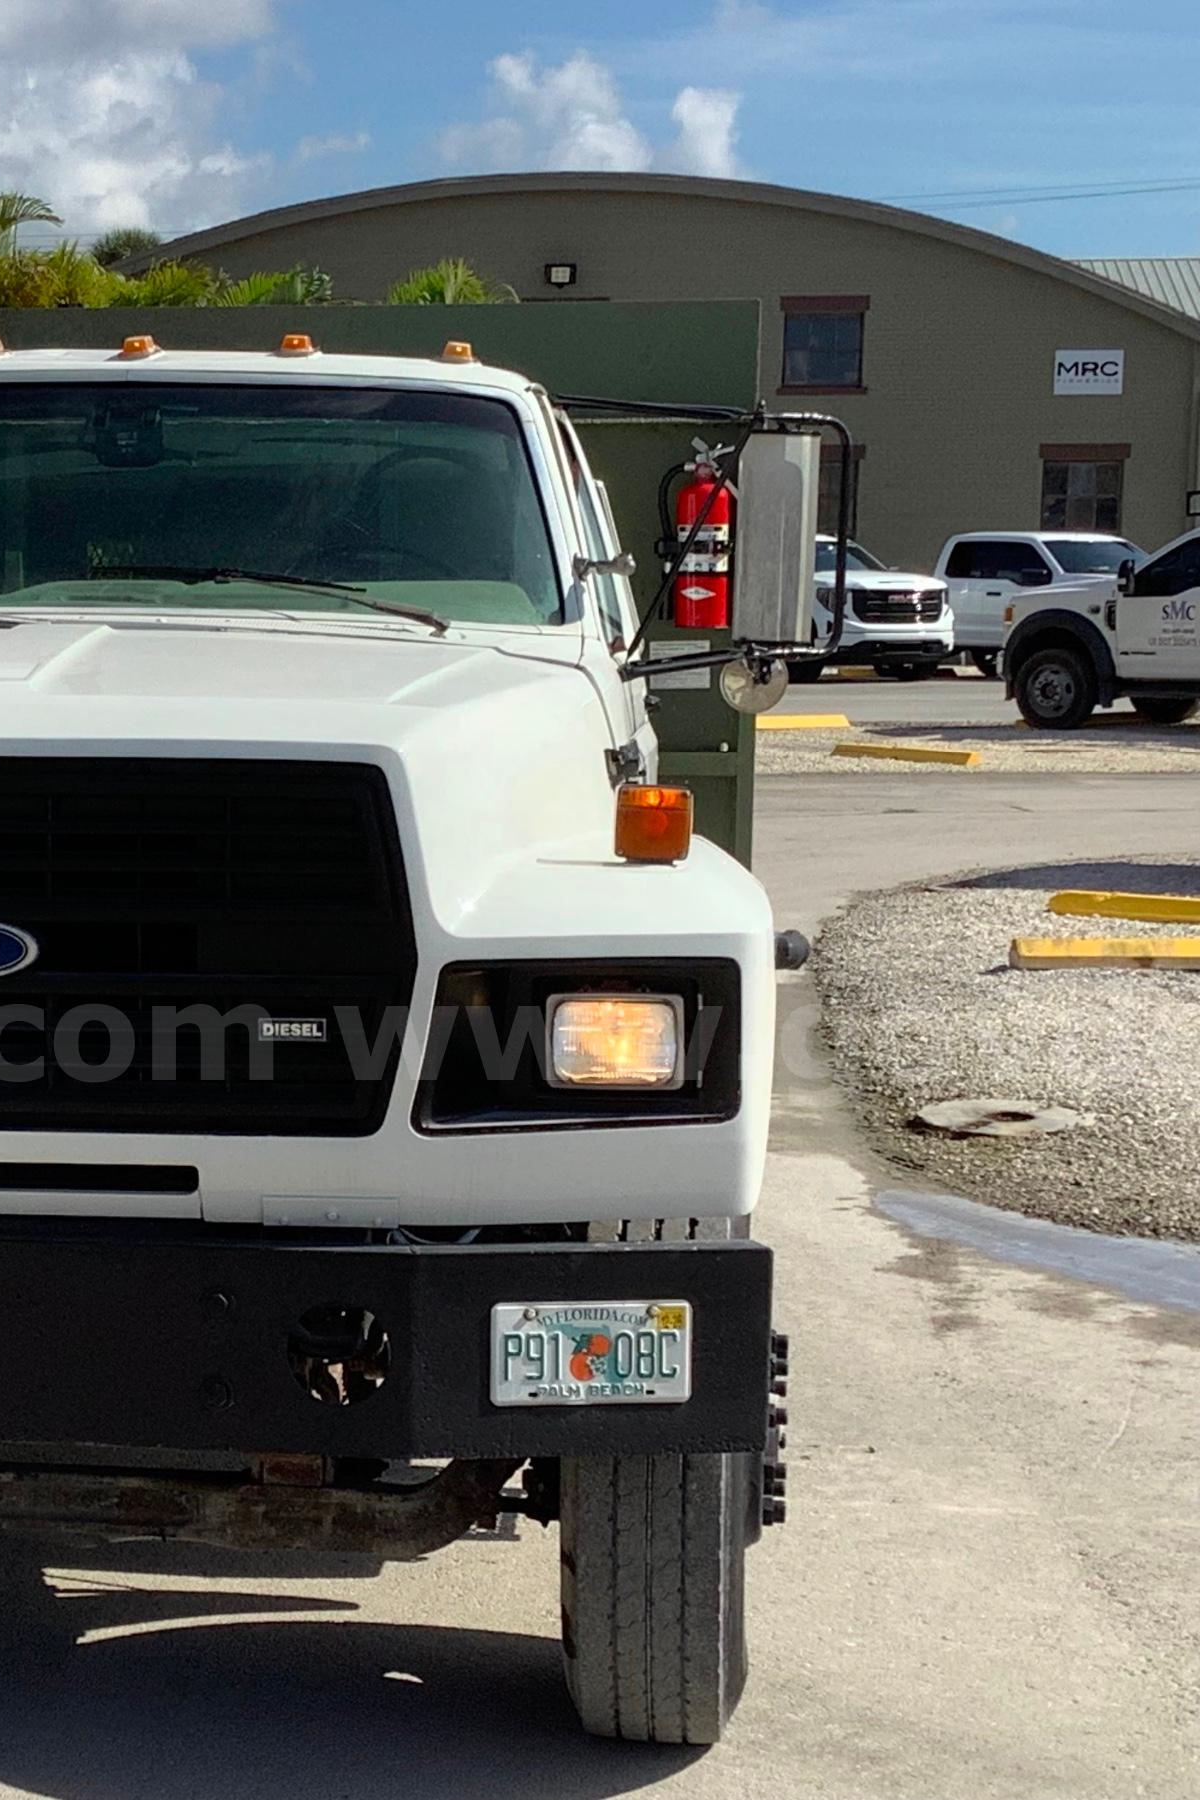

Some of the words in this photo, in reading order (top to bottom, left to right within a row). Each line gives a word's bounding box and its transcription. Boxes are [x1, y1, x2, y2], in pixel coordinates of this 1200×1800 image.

[1057, 361, 1119, 376] MRC
[1162, 600, 1196, 621] SMC
[262, 1023, 322, 1037] DIESEL
[503, 1331, 563, 1381] P91
[537, 1385, 581, 1398] PALM
[589, 1383, 646, 1396] BEACH
